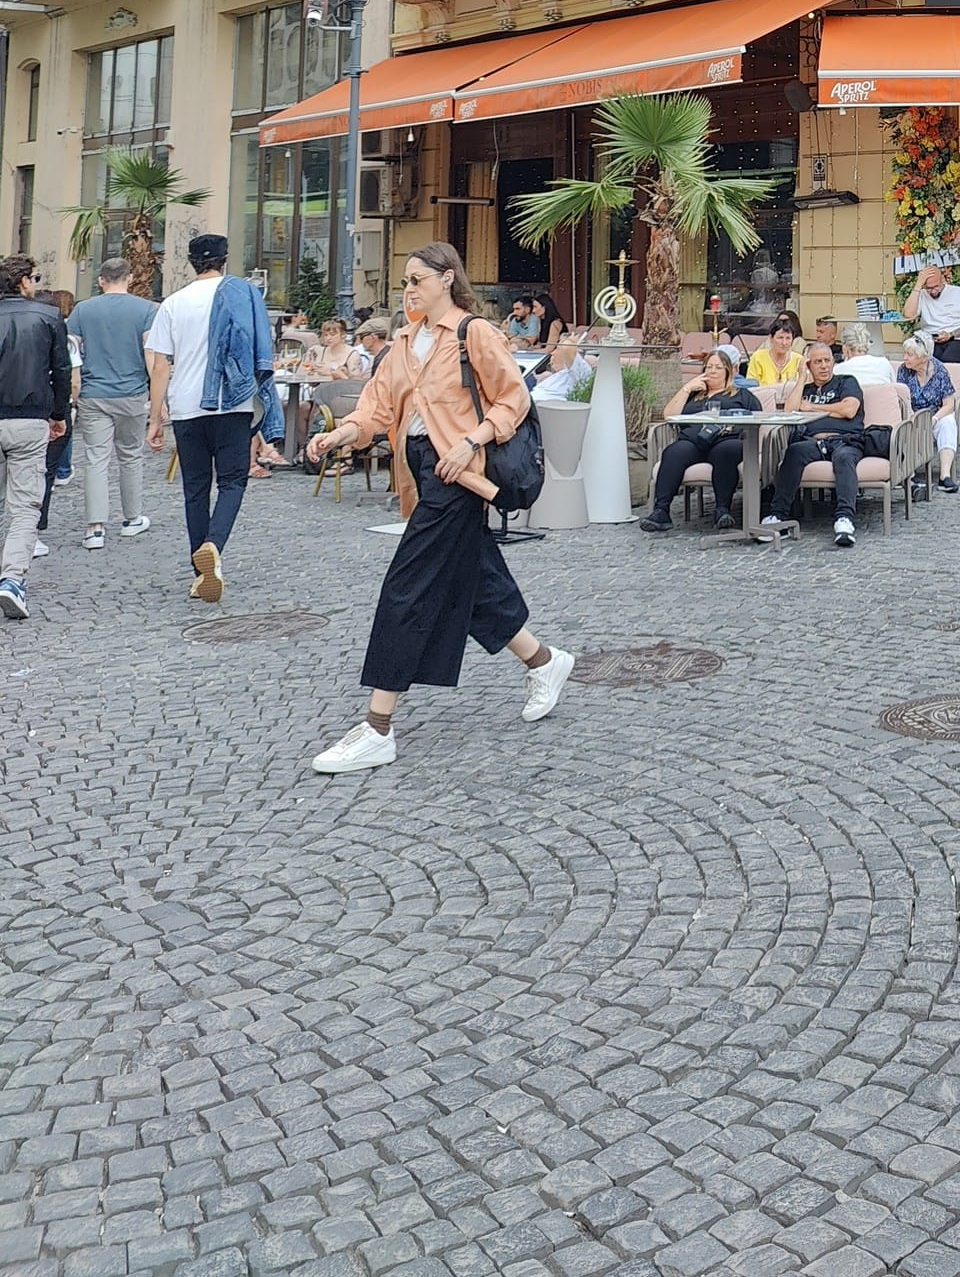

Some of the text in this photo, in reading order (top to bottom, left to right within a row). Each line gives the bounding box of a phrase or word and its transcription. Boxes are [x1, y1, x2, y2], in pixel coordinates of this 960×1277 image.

[707, 58, 734, 77] APEROL
[568, 79, 601, 97] NOBIS
[830, 80, 876, 98] APEROL
[838, 91, 869, 104] SPRITZ
